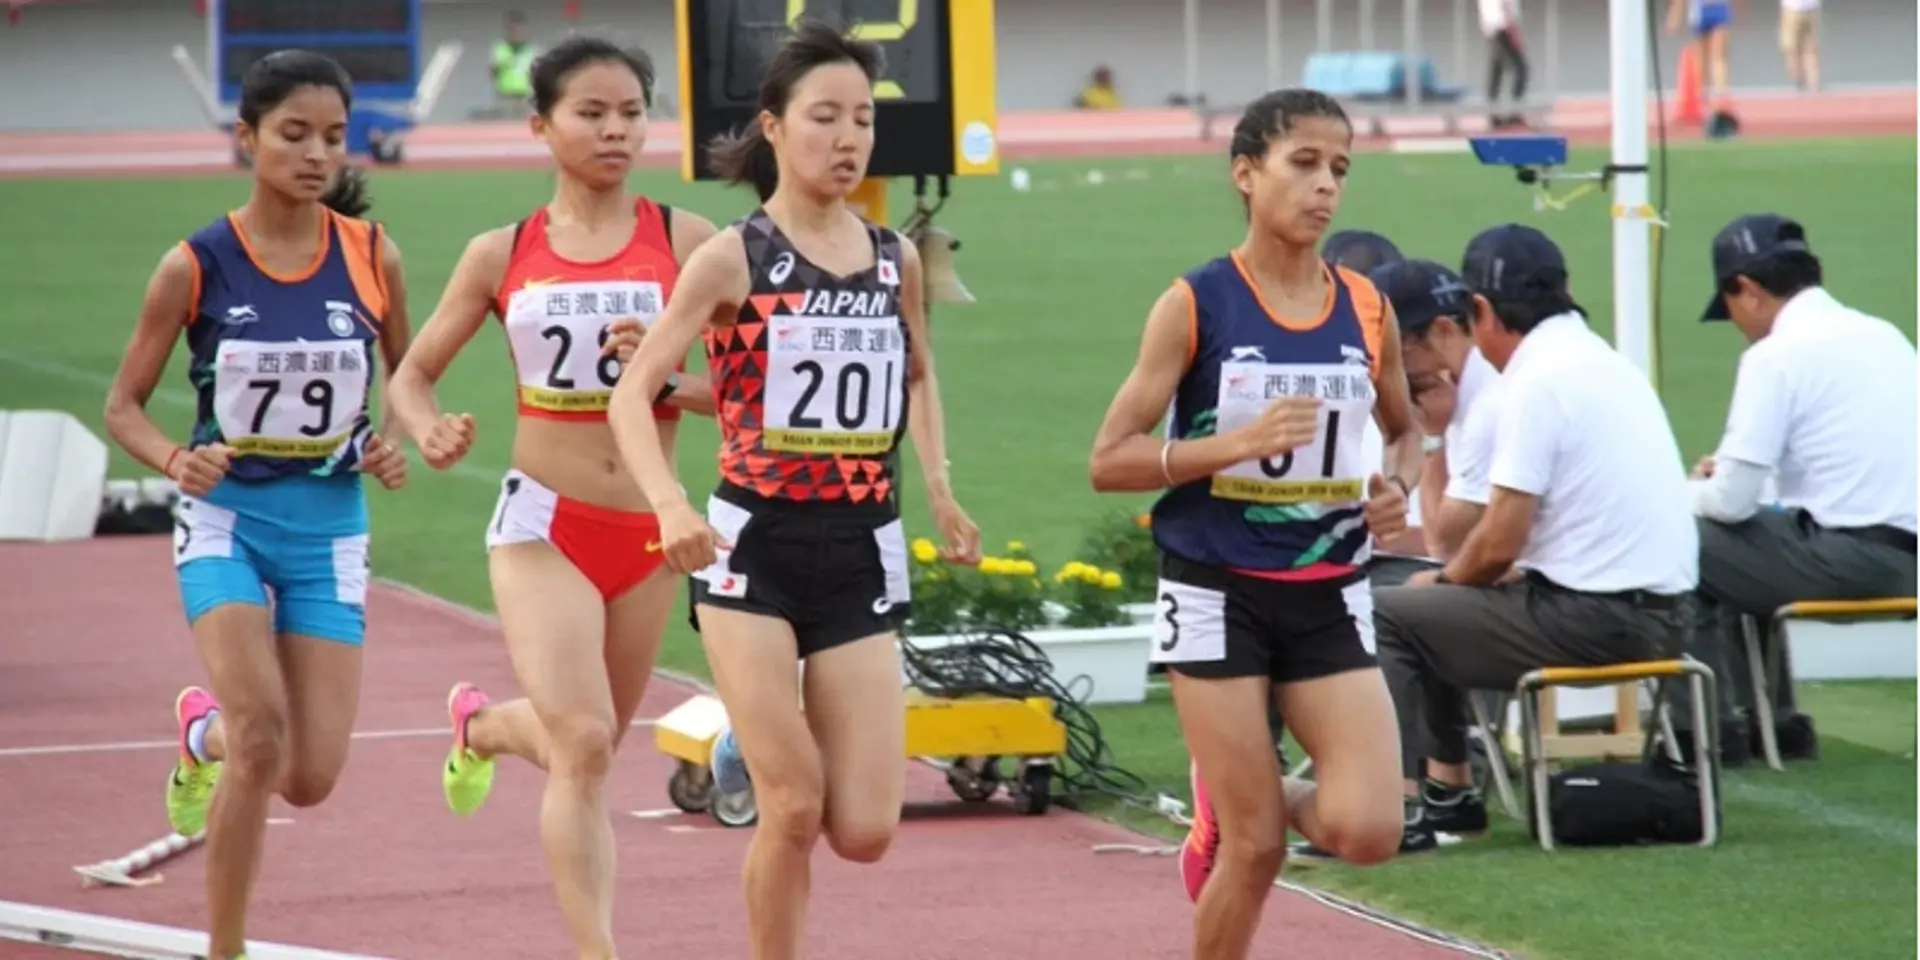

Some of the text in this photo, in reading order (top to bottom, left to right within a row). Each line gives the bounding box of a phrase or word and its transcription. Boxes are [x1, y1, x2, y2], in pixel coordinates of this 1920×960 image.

[792, 290, 887, 316] JAPAN
[248, 379, 333, 437] 79
[788, 360, 893, 429] 201
[1160, 592, 1179, 652] 3
